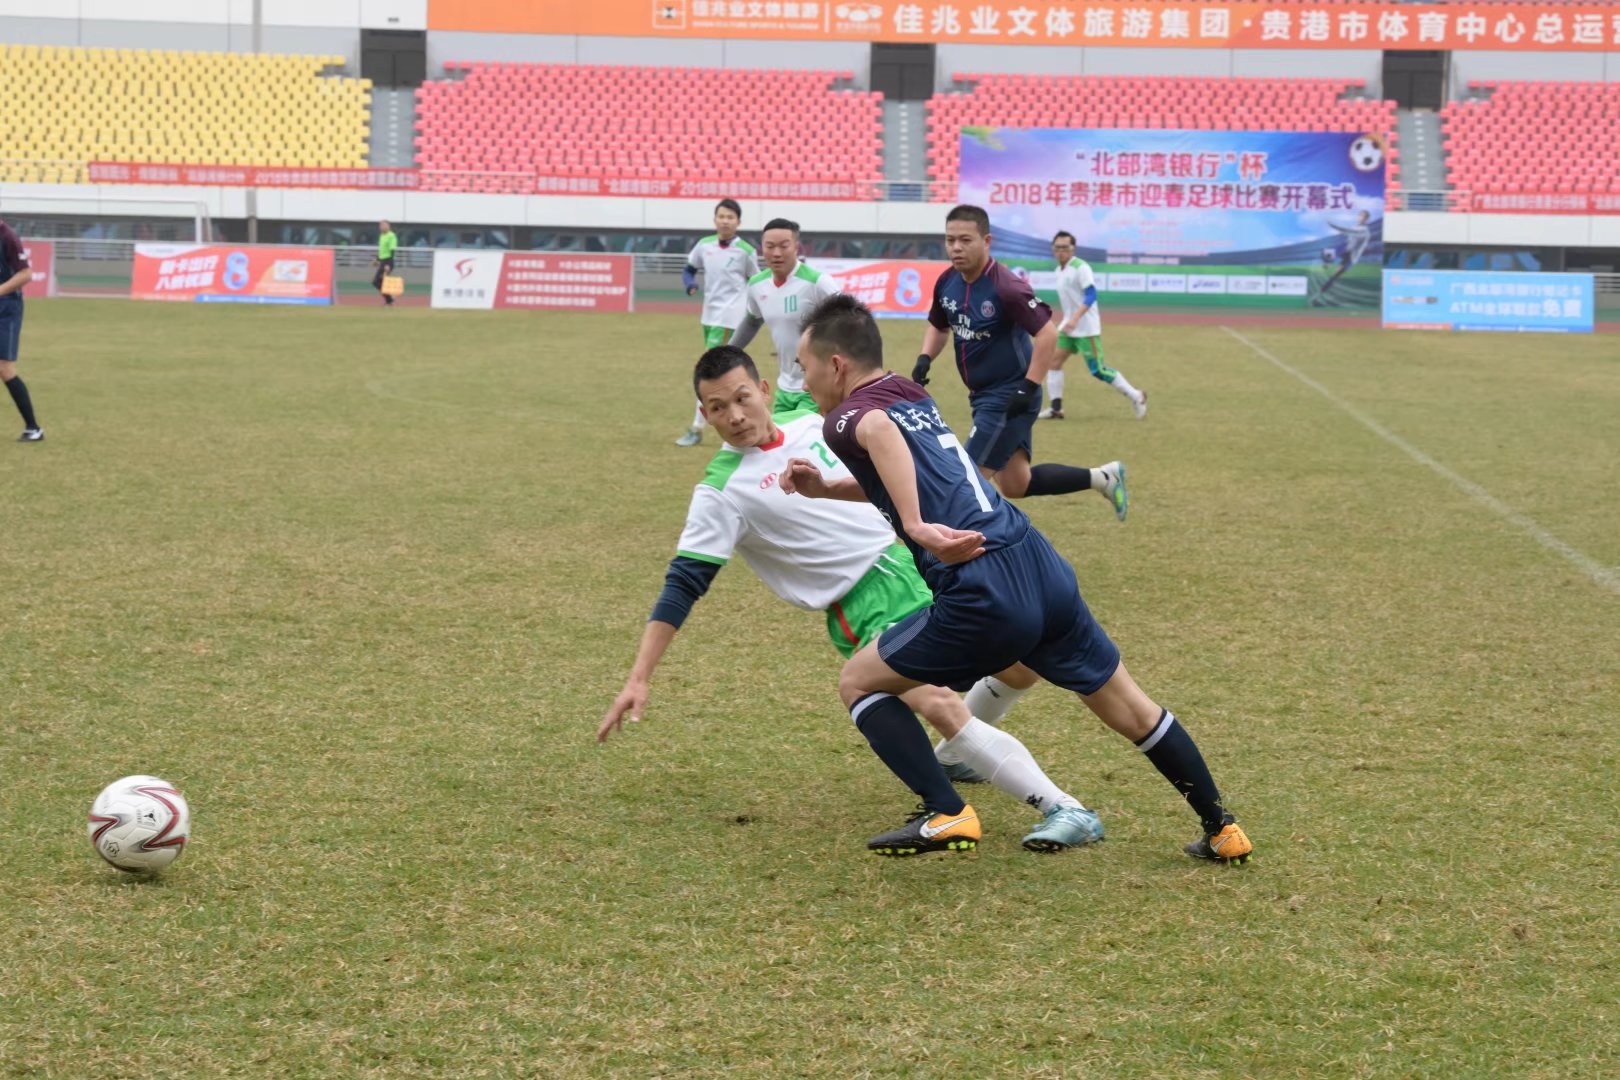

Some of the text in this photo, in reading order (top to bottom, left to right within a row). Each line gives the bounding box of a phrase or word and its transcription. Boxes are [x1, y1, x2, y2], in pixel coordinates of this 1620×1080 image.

[988, 180, 1355, 211] 2018年贵港市迎春足球比赛开幕式
[222, 251, 250, 290] 8
[783, 294, 798, 314] 10
[808, 441, 838, 469] 2
[936, 432, 994, 513] 7
